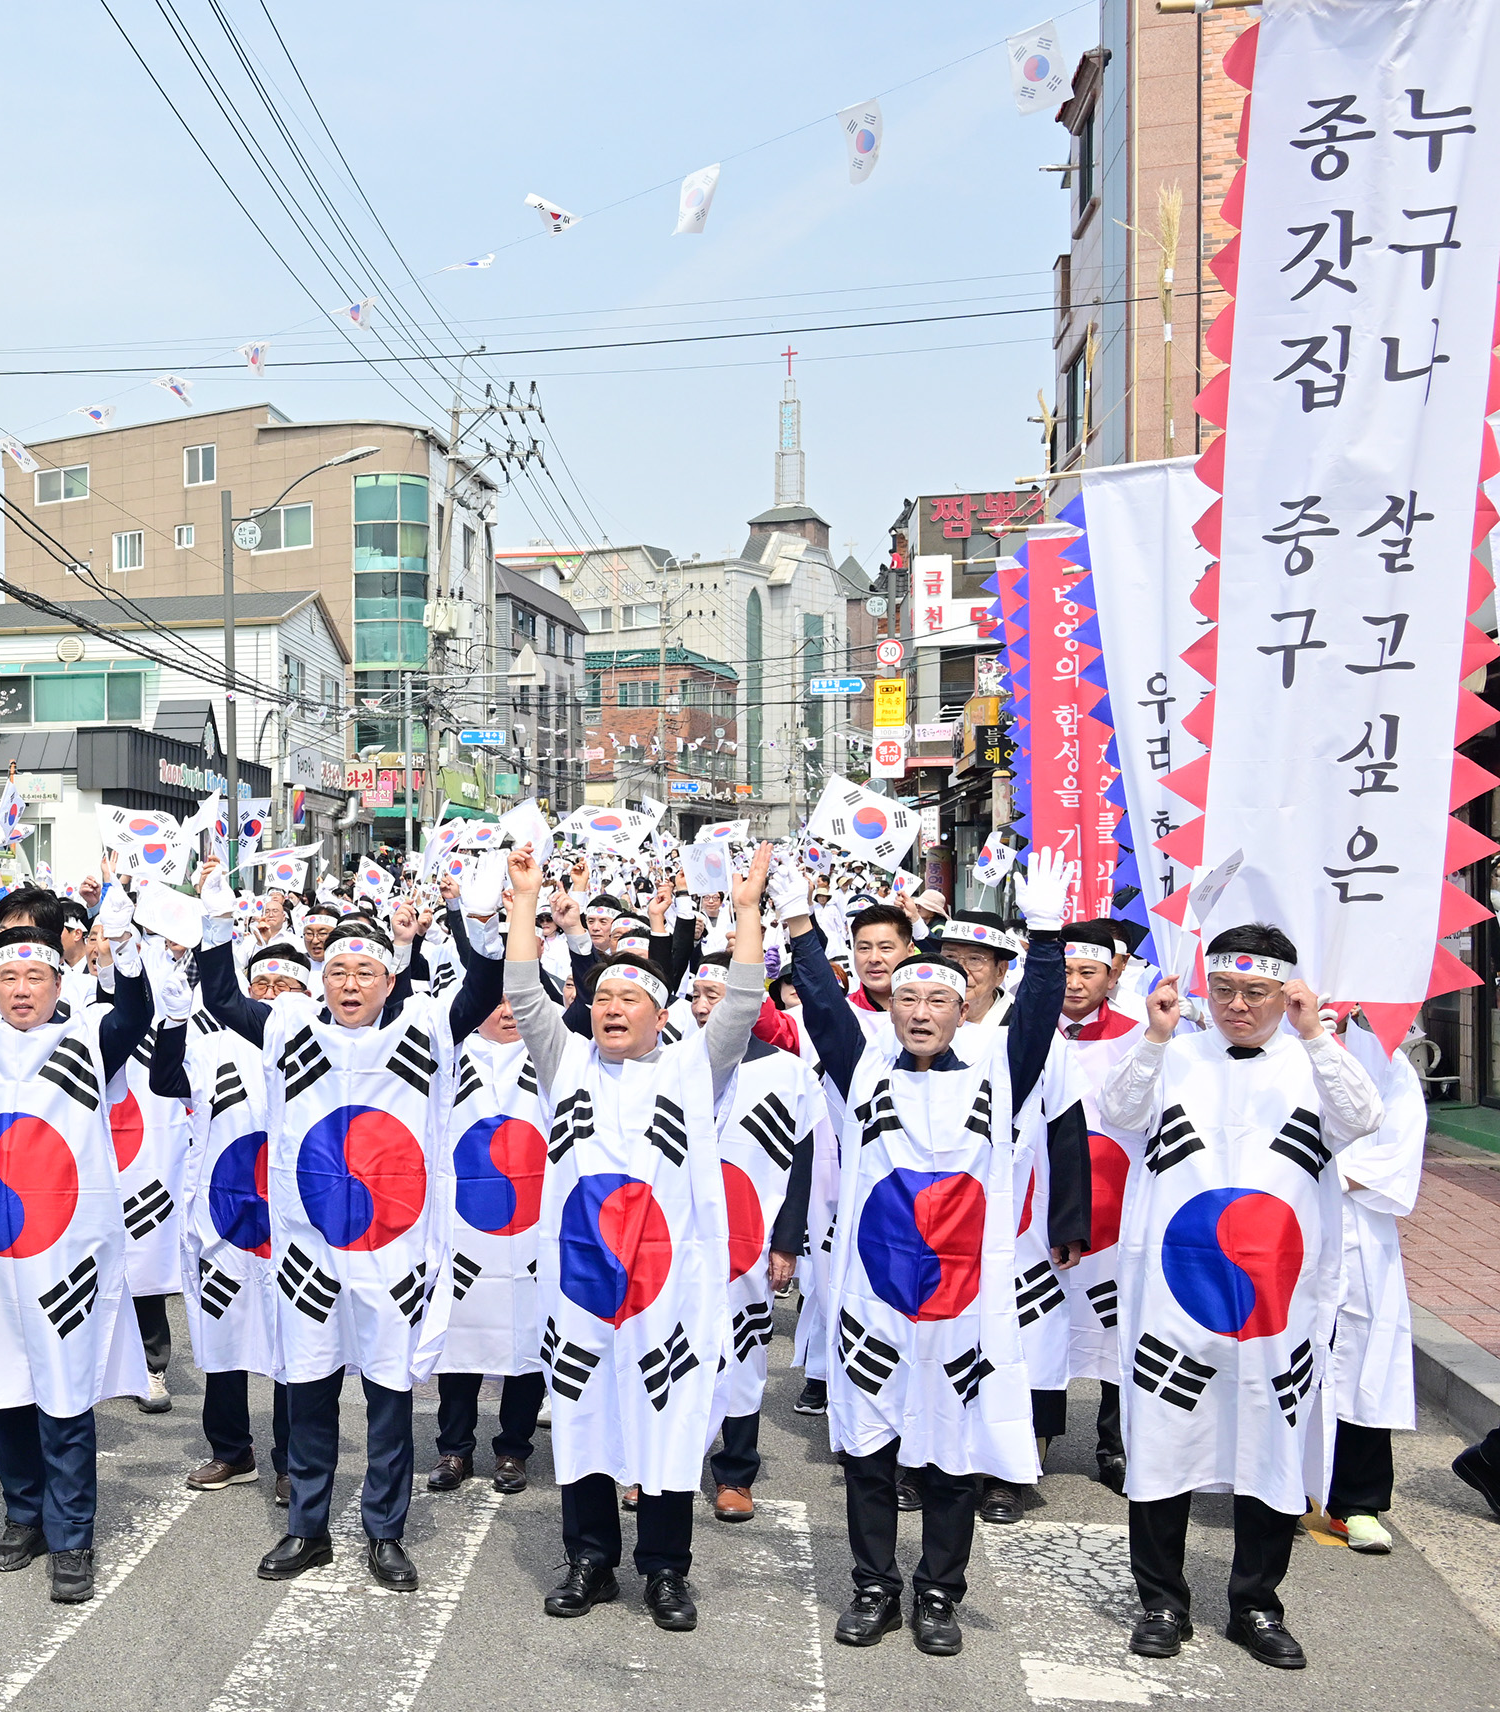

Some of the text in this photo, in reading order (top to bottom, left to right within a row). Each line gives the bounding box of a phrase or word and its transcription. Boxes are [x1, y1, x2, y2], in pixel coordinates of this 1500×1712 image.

[1380, 88, 1477, 407] 누구나
[1256, 94, 1377, 690] 종갓집 중구
[237, 525, 257, 536] 한글
[238, 536, 257, 545] 거리
[868, 599, 884, 607] 한글
[923, 570, 945, 631] 금천
[868, 606, 884, 614] 거리
[1051, 582, 1081, 689] 병영의
[883, 646, 898, 658] 30
[878, 745, 898, 755] 정지
[1051, 703, 1084, 808] 함성을
[879, 755, 900, 763] STOP
[346, 769, 375, 790] 파전
[19, 793, 59, 801] 온수피아유치원
[365, 783, 392, 803] 반찬
[950, 924, 972, 937] 대한
[365, 942, 384, 960] 독립
[1079, 945, 1100, 958] 독립
[281, 962, 300, 977] 독립
[1212, 954, 1281, 977] 대한 독립
[640, 963, 660, 994] 독립
[709, 967, 729, 982] 독립
[936, 968, 958, 987] 독립
